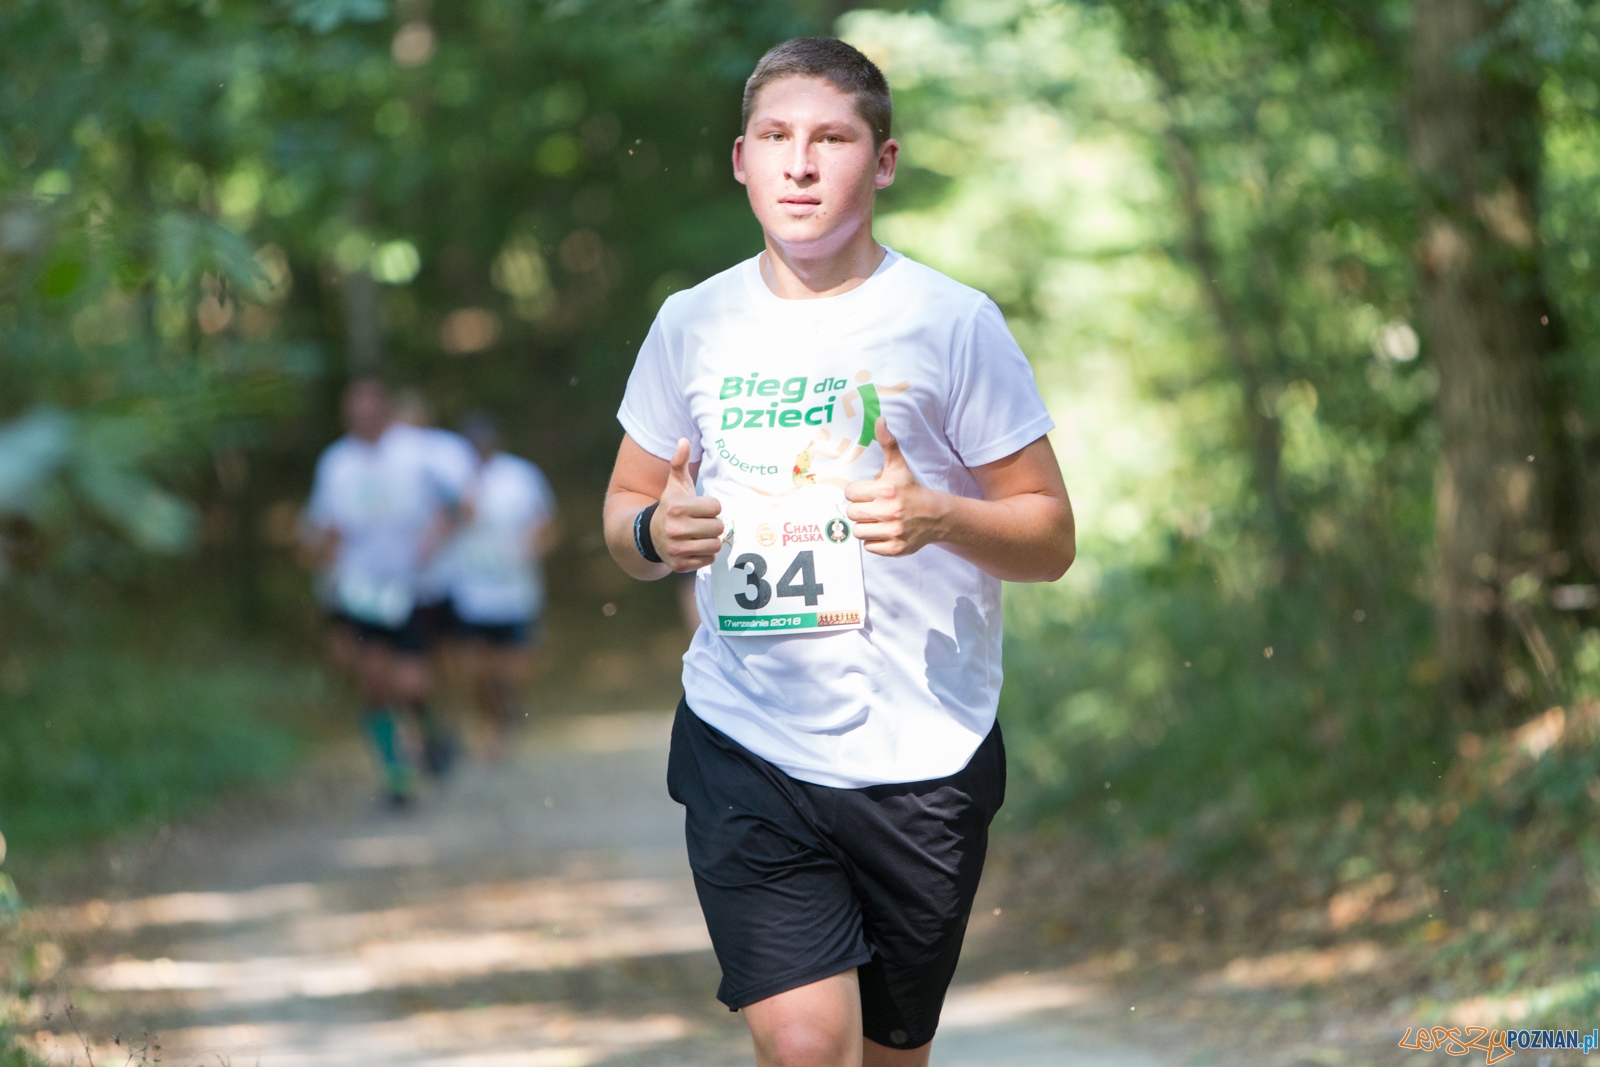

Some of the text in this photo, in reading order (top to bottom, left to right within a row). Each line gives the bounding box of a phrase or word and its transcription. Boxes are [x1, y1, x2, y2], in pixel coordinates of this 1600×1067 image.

[720, 372, 848, 403] Bieg dla
[720, 396, 837, 430] Dzieci
[715, 438, 779, 475] Roberta
[734, 550, 824, 610] 34
[723, 619, 732, 628] 17
